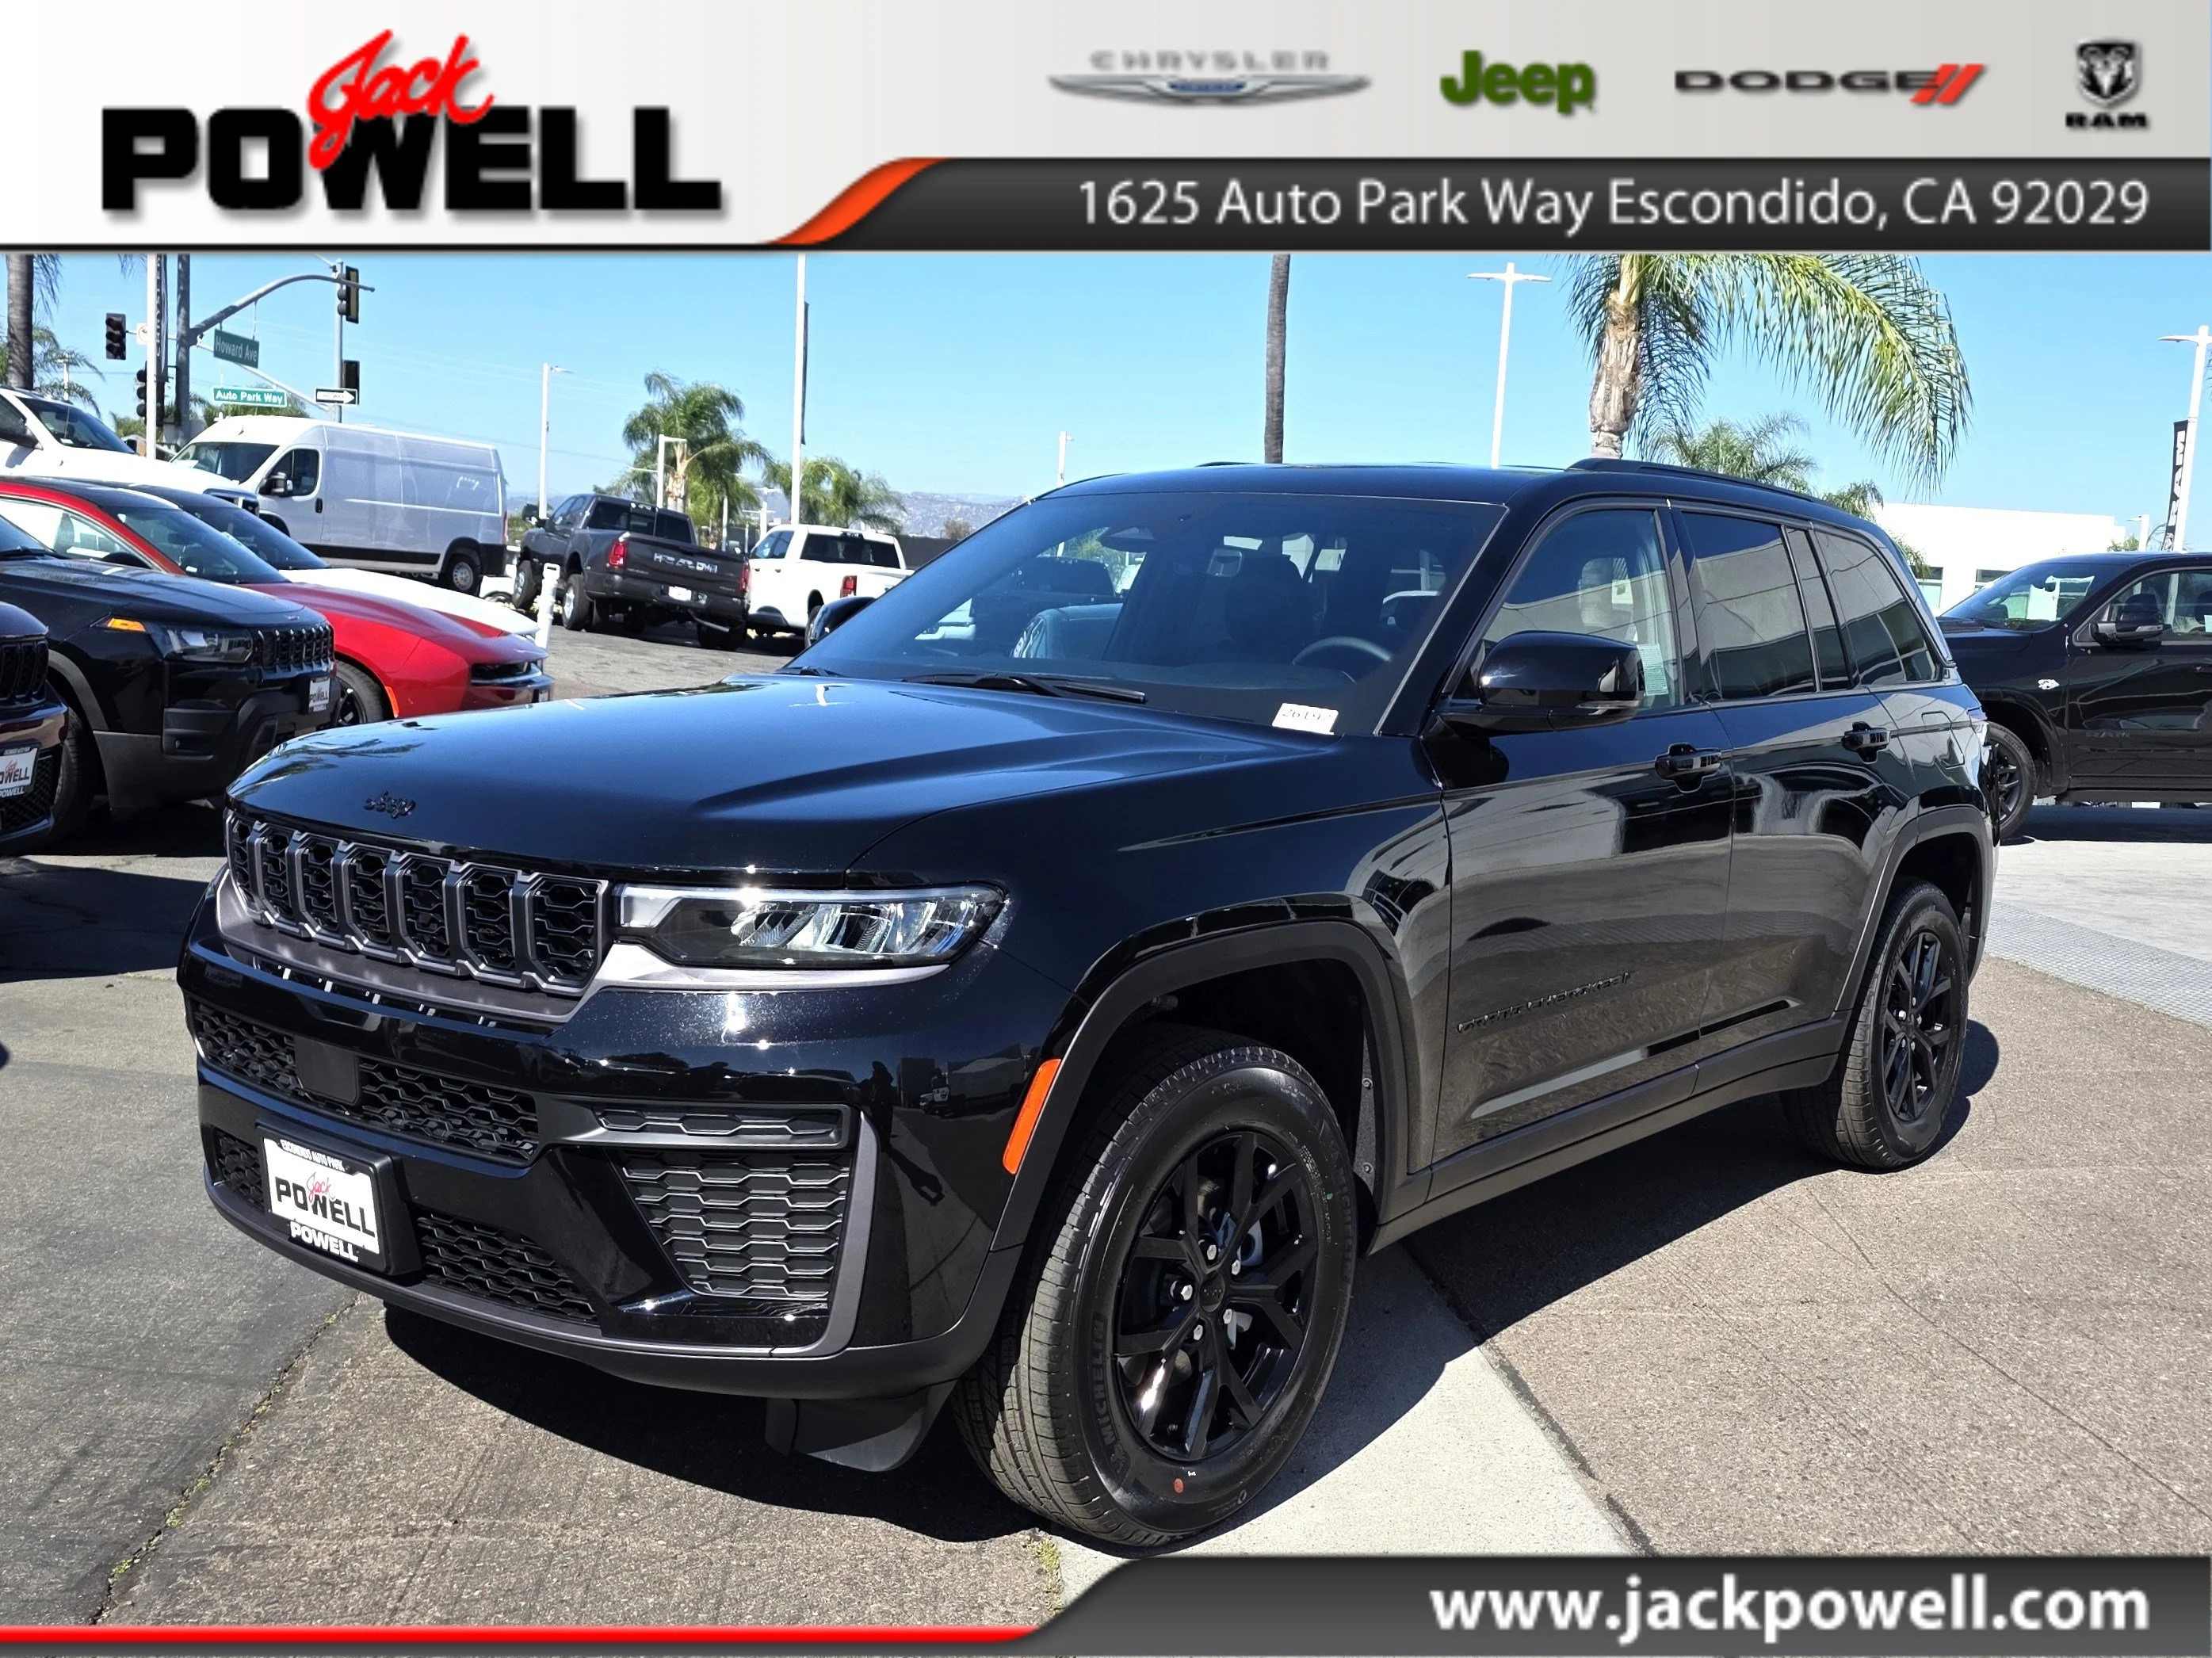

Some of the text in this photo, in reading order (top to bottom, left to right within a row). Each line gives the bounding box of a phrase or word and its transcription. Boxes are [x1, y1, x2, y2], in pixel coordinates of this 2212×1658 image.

[215, 334, 258, 362] Howard Ave
[216, 389, 284, 405] Auto Park Way
[307, 1171, 336, 1204] Jack
[275, 1177, 376, 1239] POWELL
[290, 1221, 359, 1263] POWELL
[1093, 1319, 1116, 1447] MICHELIN
